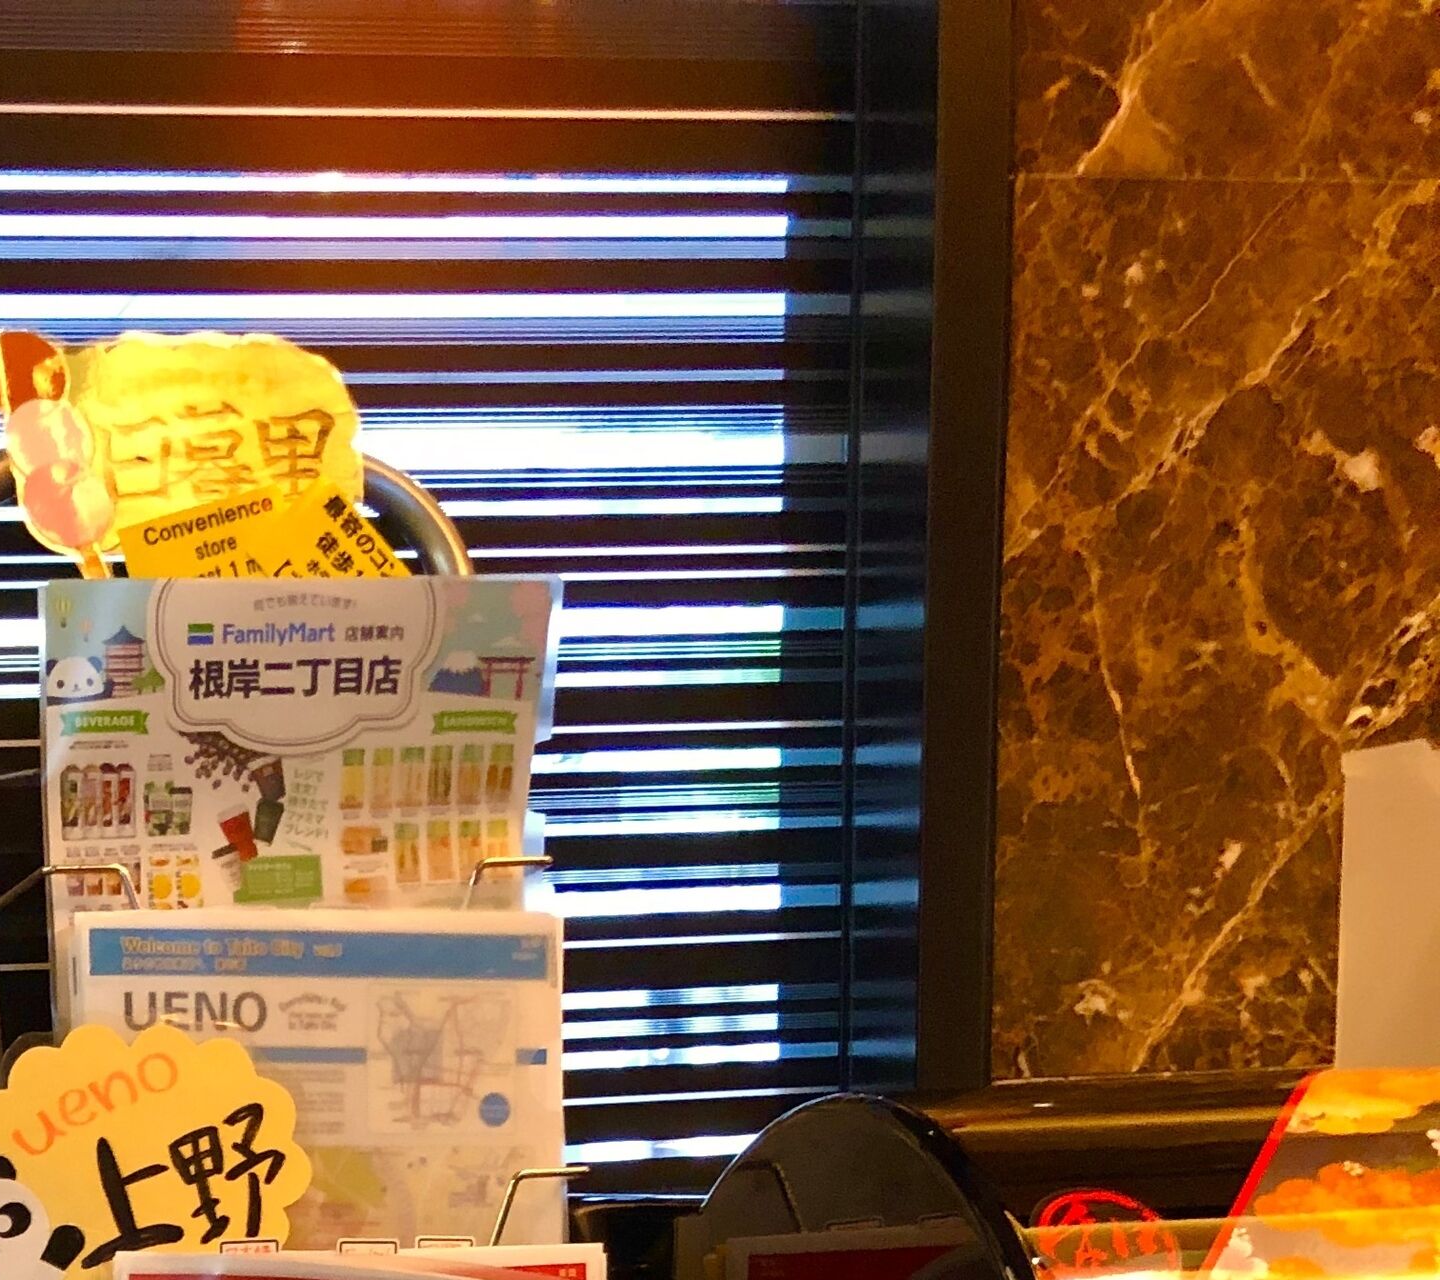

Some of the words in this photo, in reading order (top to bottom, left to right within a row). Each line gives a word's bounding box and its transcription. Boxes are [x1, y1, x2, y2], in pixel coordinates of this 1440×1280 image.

[143, 498, 273, 546] Convenience
[195, 534, 238, 560] store
[221, 622, 336, 647] FamilyMart
[188, 655, 402, 700] 根岸二丁目店
[123, 990, 268, 1034] UENO
[10, 1050, 181, 1158] ueno
[80, 1101, 286, 1270] 上野
